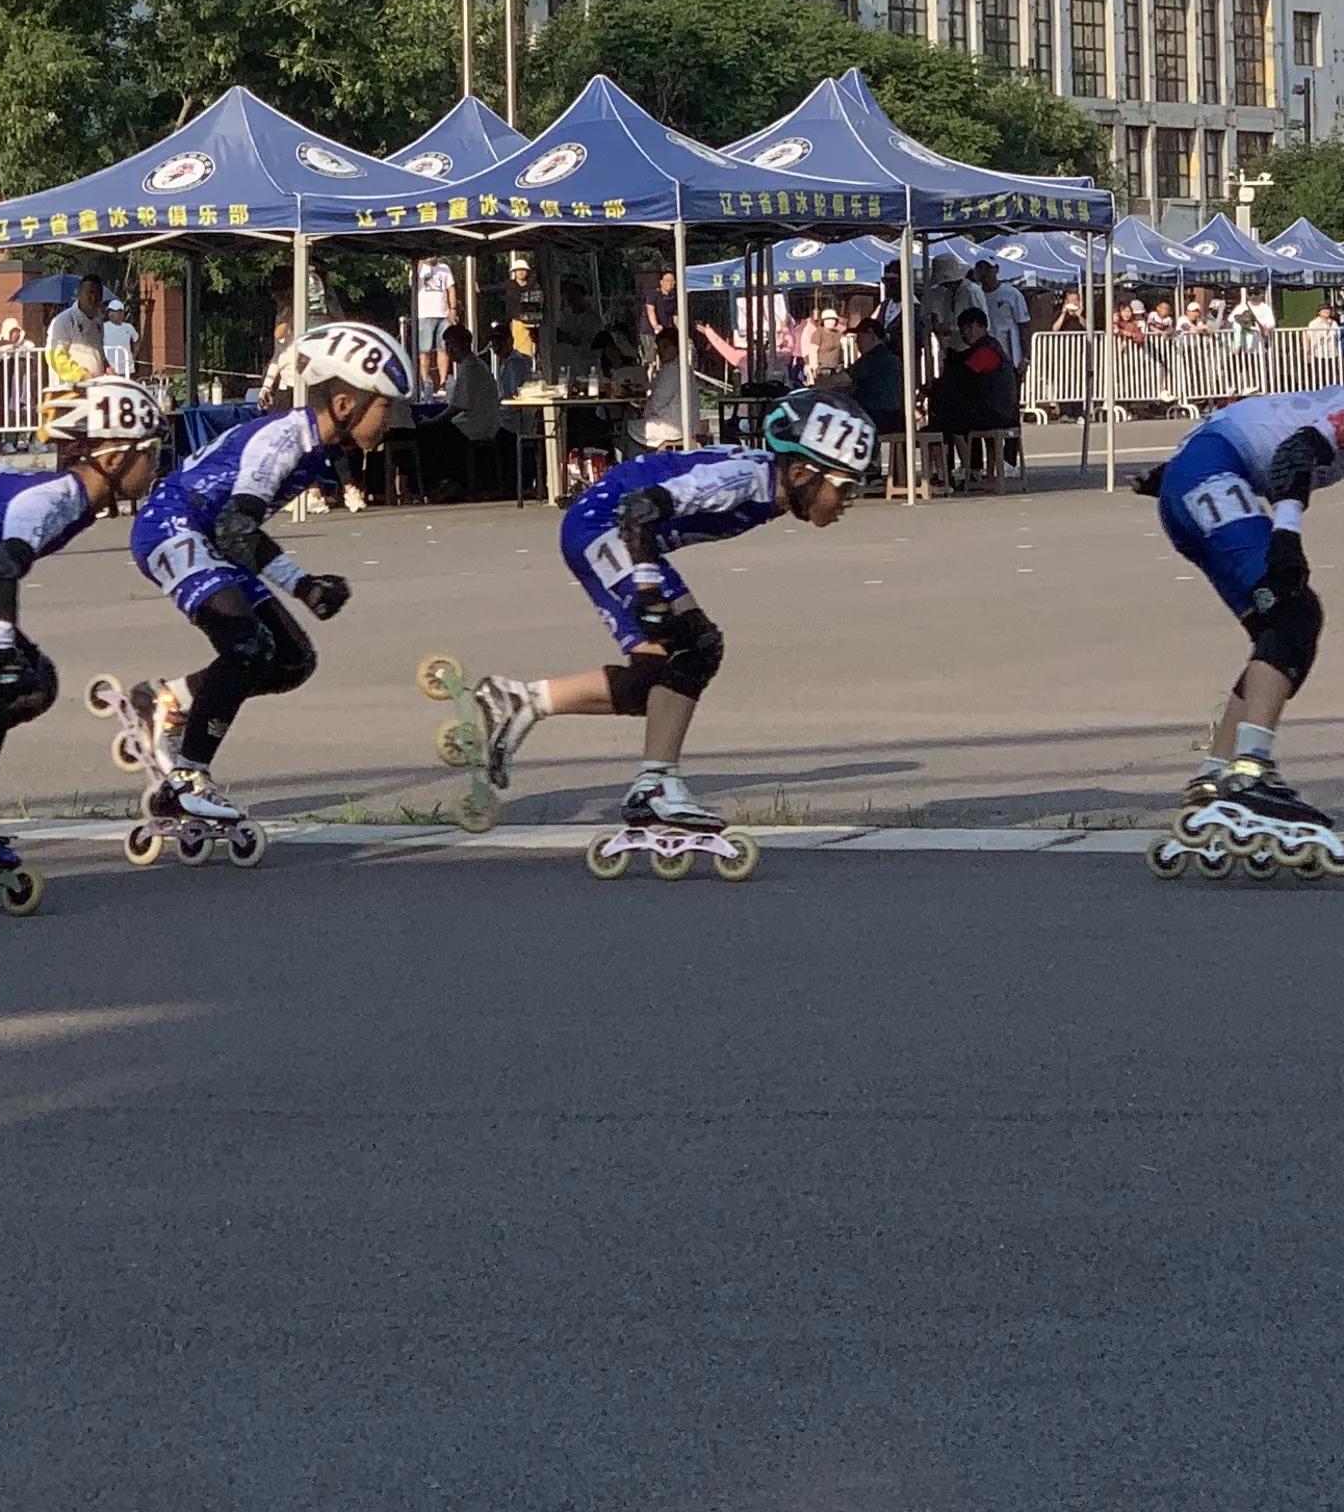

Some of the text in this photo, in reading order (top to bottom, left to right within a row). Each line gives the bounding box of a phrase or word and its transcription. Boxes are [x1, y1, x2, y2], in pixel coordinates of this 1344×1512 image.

[327, 331, 382, 375] 178
[94, 396, 158, 431] 183
[816, 413, 872, 465] 175
[1197, 483, 1266, 524] 11
